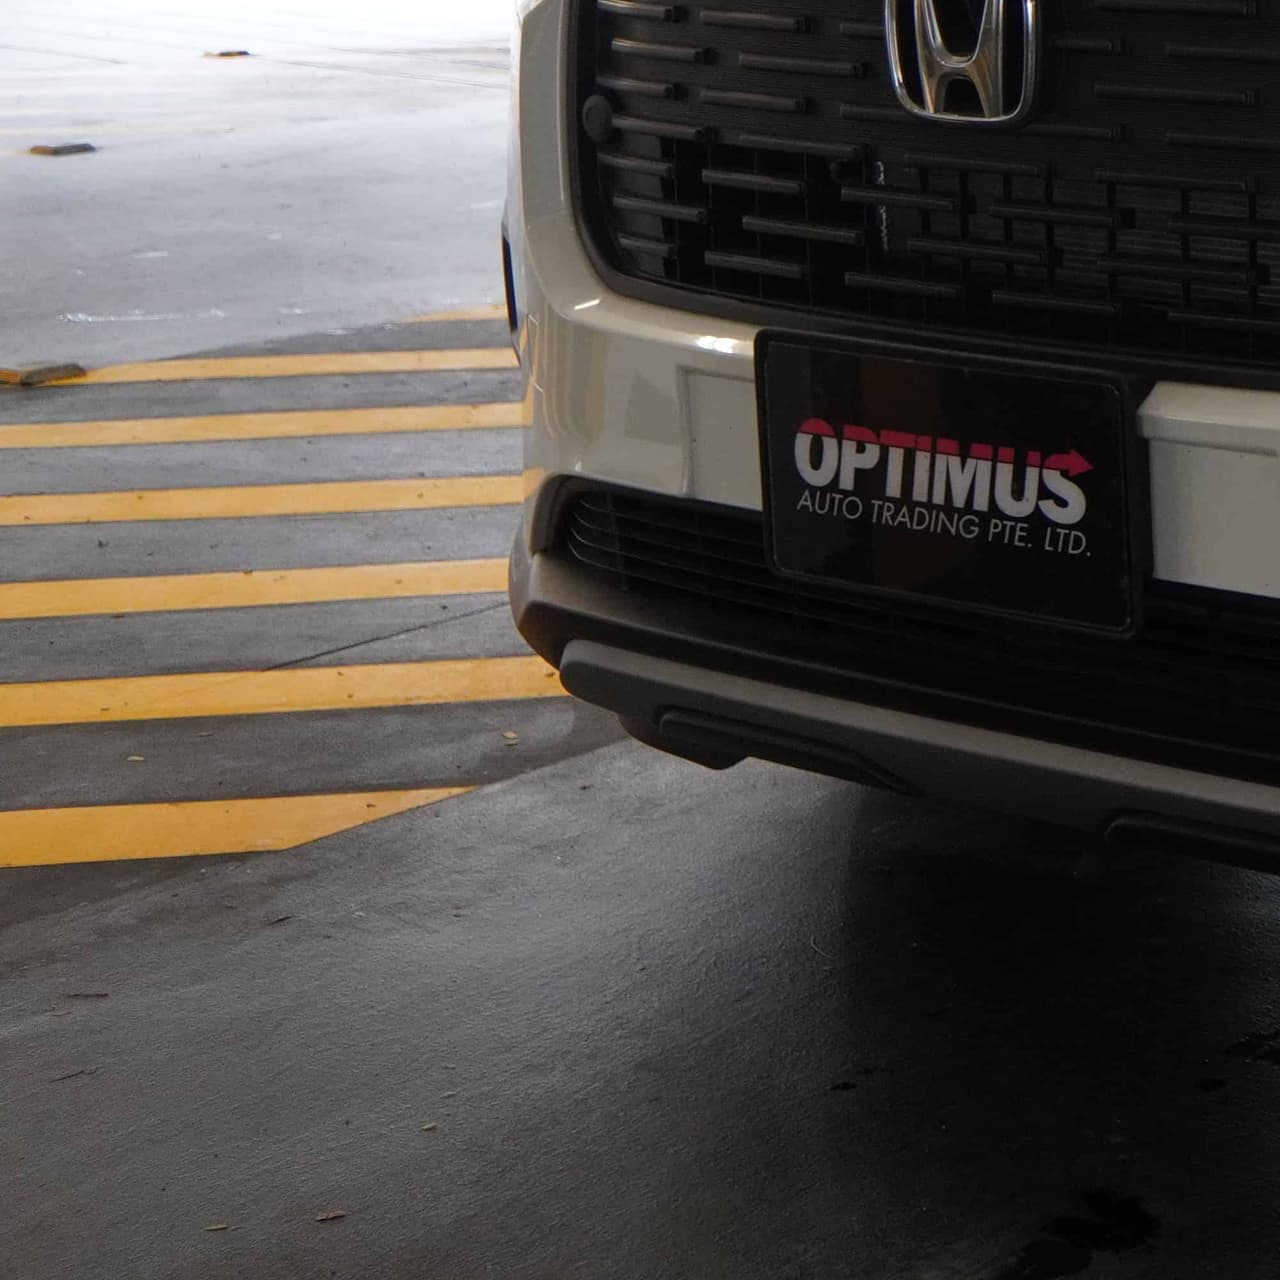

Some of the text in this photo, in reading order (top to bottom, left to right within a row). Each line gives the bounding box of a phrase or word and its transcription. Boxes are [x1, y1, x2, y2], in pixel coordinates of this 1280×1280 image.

[793, 417, 1092, 525] OPTIMUS
[796, 489, 1092, 557] AUTO TRADING PTE. LTD.
